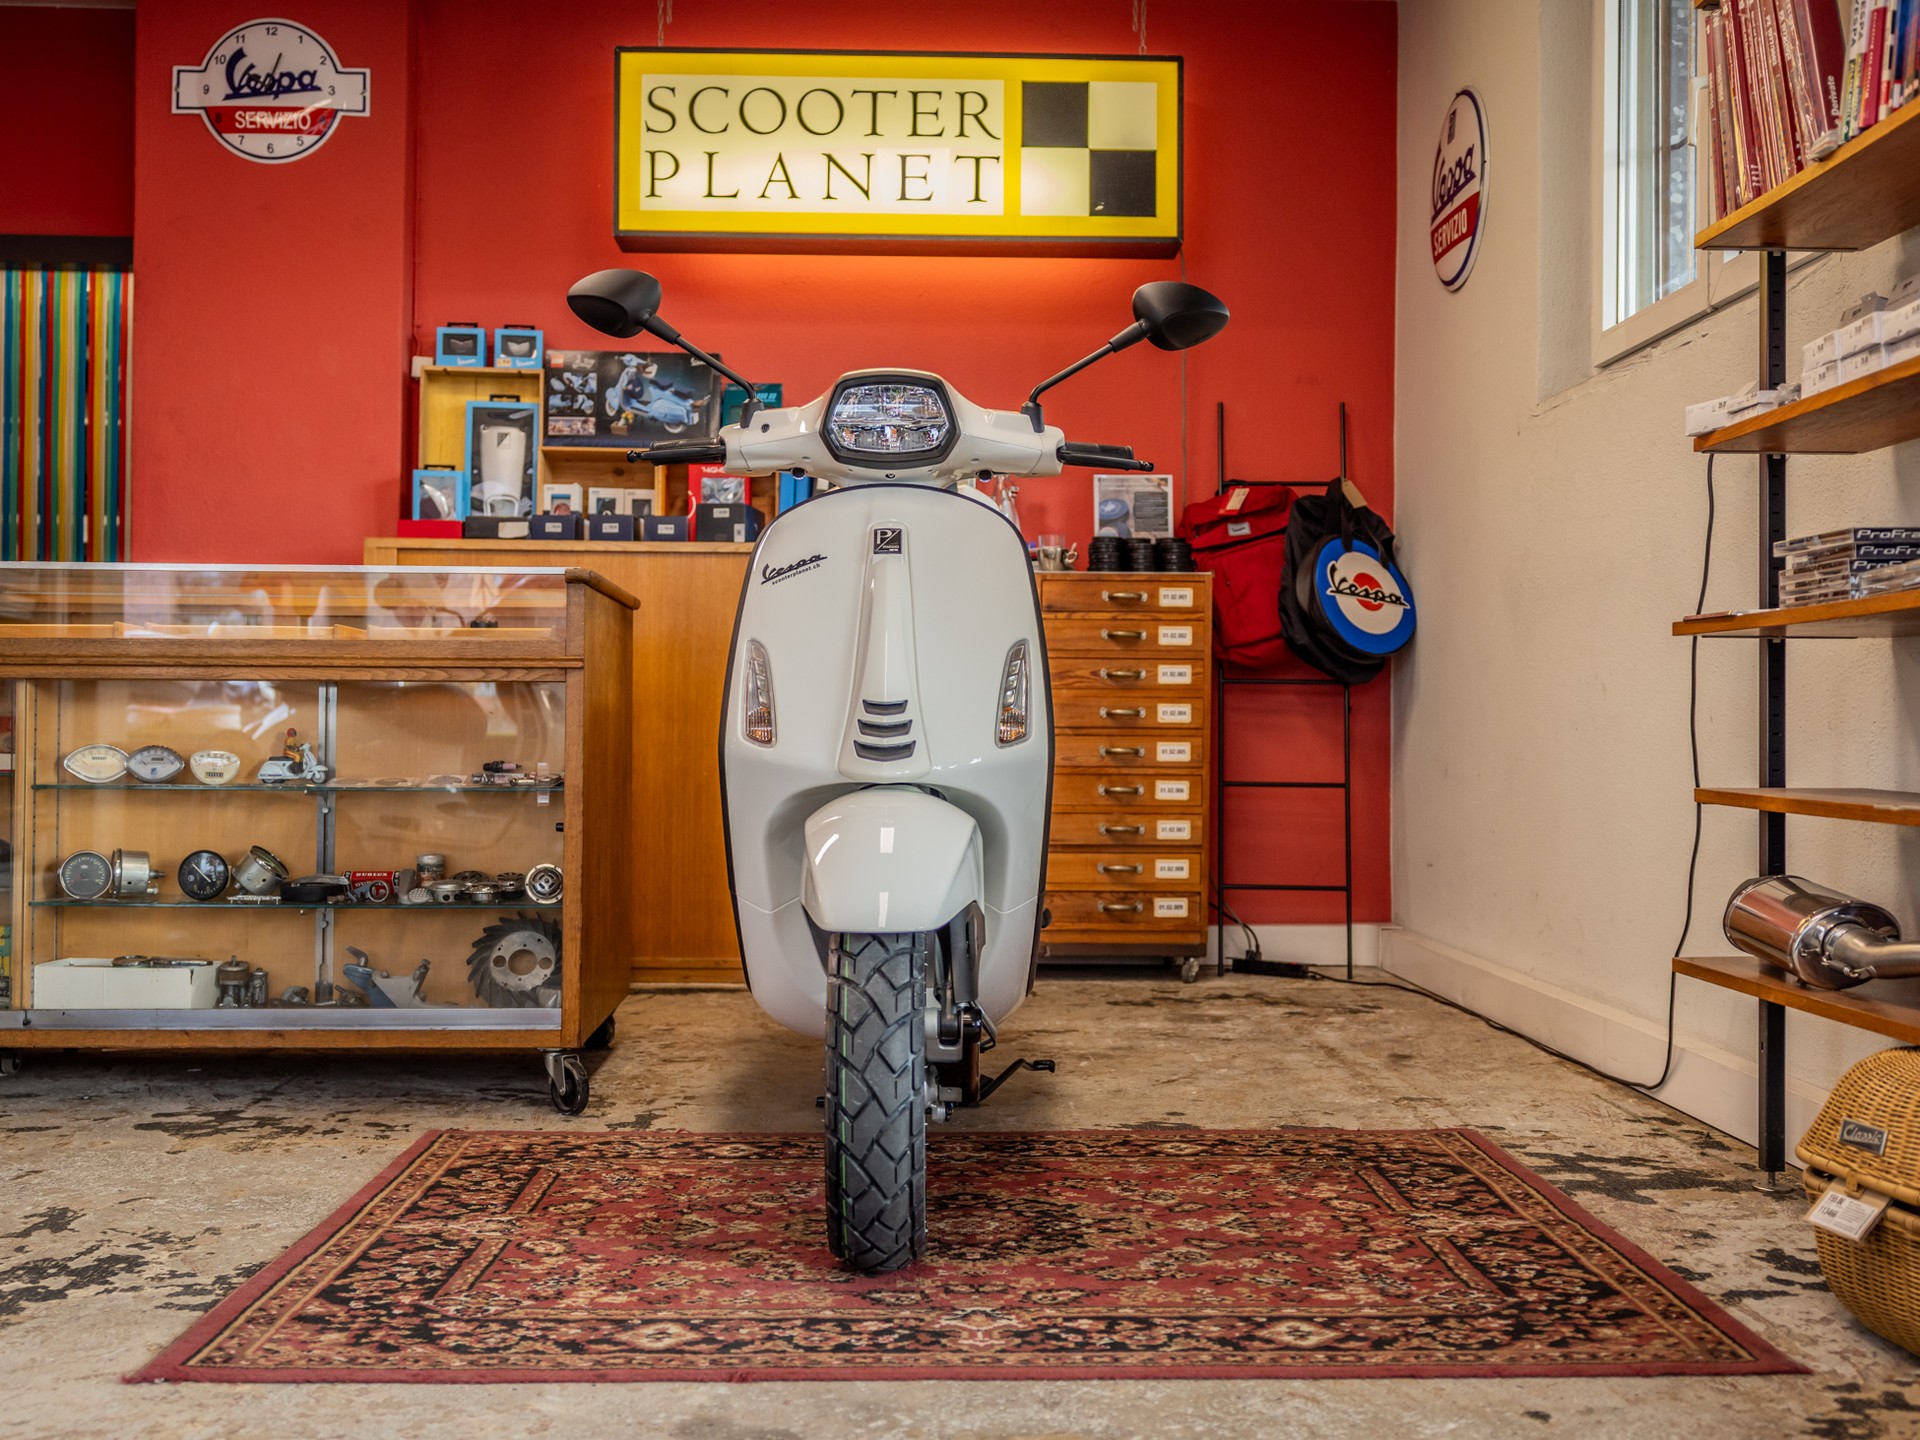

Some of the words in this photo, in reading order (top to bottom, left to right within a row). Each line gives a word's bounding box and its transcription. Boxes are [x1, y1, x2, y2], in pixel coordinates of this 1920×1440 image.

[235, 34, 246, 44] 11
[265, 26, 278, 36] 12
[298, 35, 303, 44] 1
[214, 54, 226, 65] 10
[320, 56, 327, 66] 2
[222, 47, 322, 100] Vespa
[203, 84, 210, 94] 9
[328, 85, 336, 96] 3
[1828, 75, 1840, 116] Derivate
[215, 112, 222, 124] 8
[234, 110, 311, 130] SERVIZIO
[645, 86, 1001, 140] SCOOTER
[238, 135, 245, 145] 7
[297, 136, 304, 146] 5
[267, 143, 274, 154] 6
[645, 150, 1000, 202] PLANET
[1431, 144, 1476, 225] Vespa
[1434, 207, 1468, 256] SERVIZIO
[761, 554, 828, 585] Vespa
[772, 563, 820, 585] scooterplanet.ch
[1328, 562, 1409, 608] Vespa
[1843, 1124, 1882, 1144] Classic
